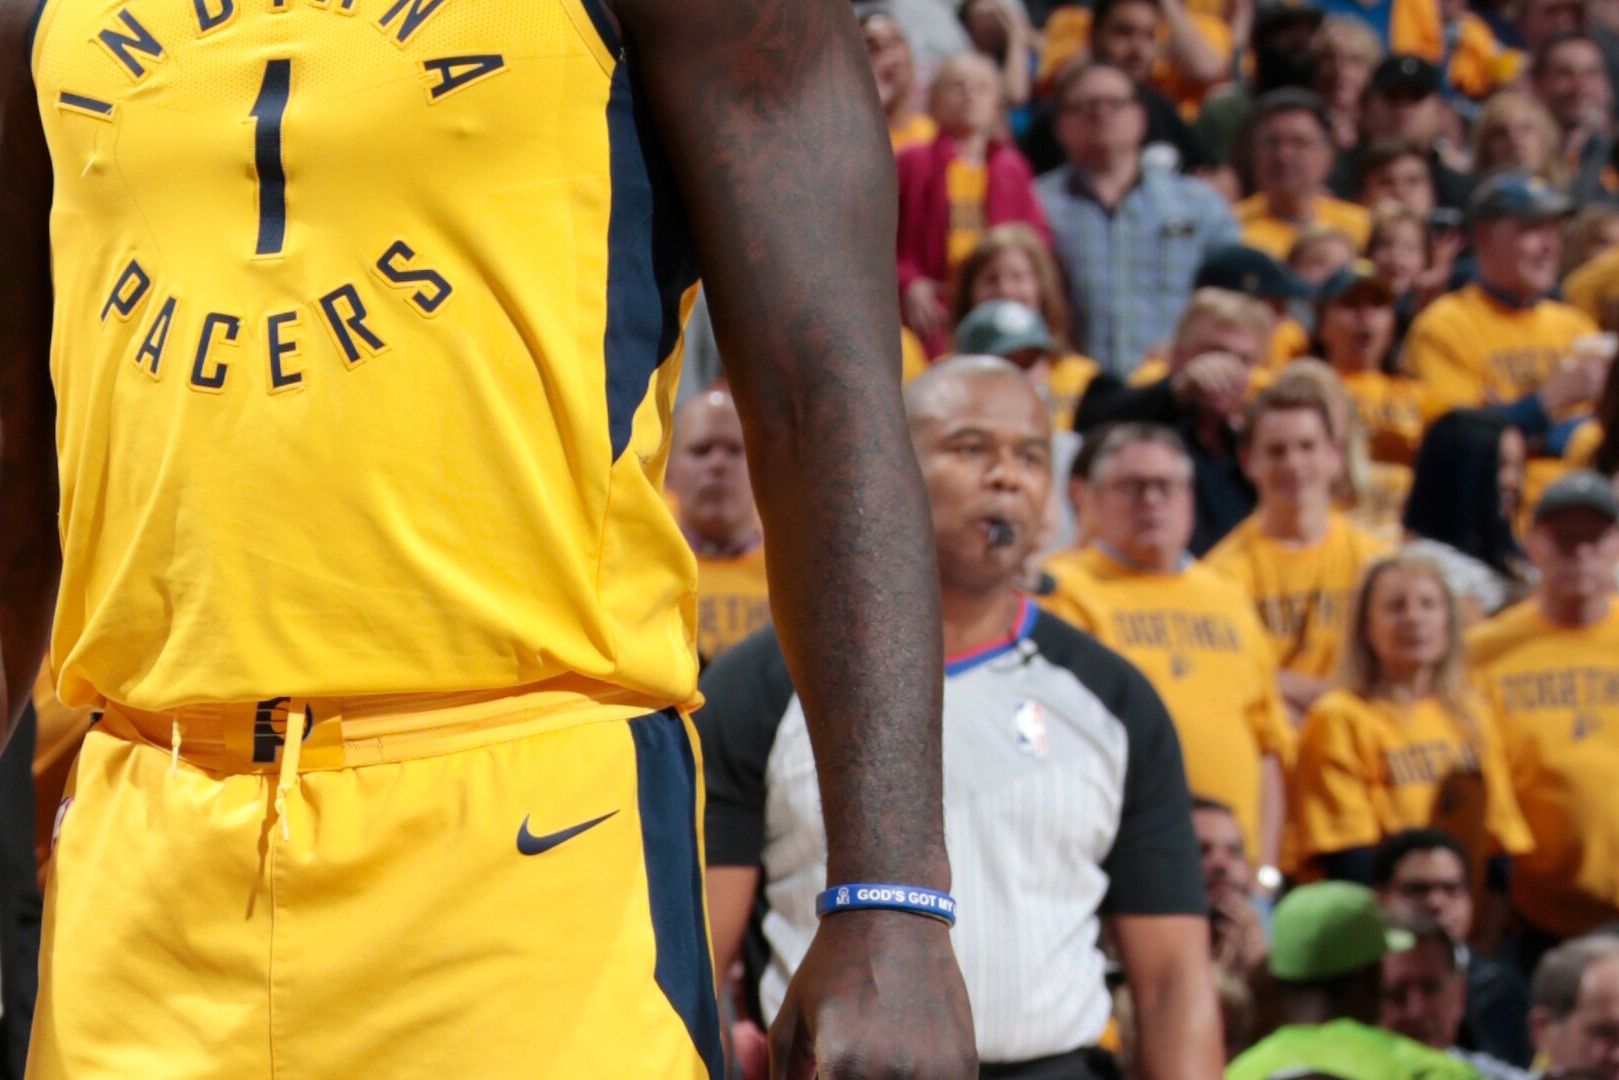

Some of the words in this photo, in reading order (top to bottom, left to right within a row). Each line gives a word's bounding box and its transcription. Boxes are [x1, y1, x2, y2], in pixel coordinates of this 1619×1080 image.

[248, 58, 292, 256] 1
[100, 239, 455, 392] PACERS
[856, 888, 906, 903] GOD'S
[908, 891, 937, 907] GOT
